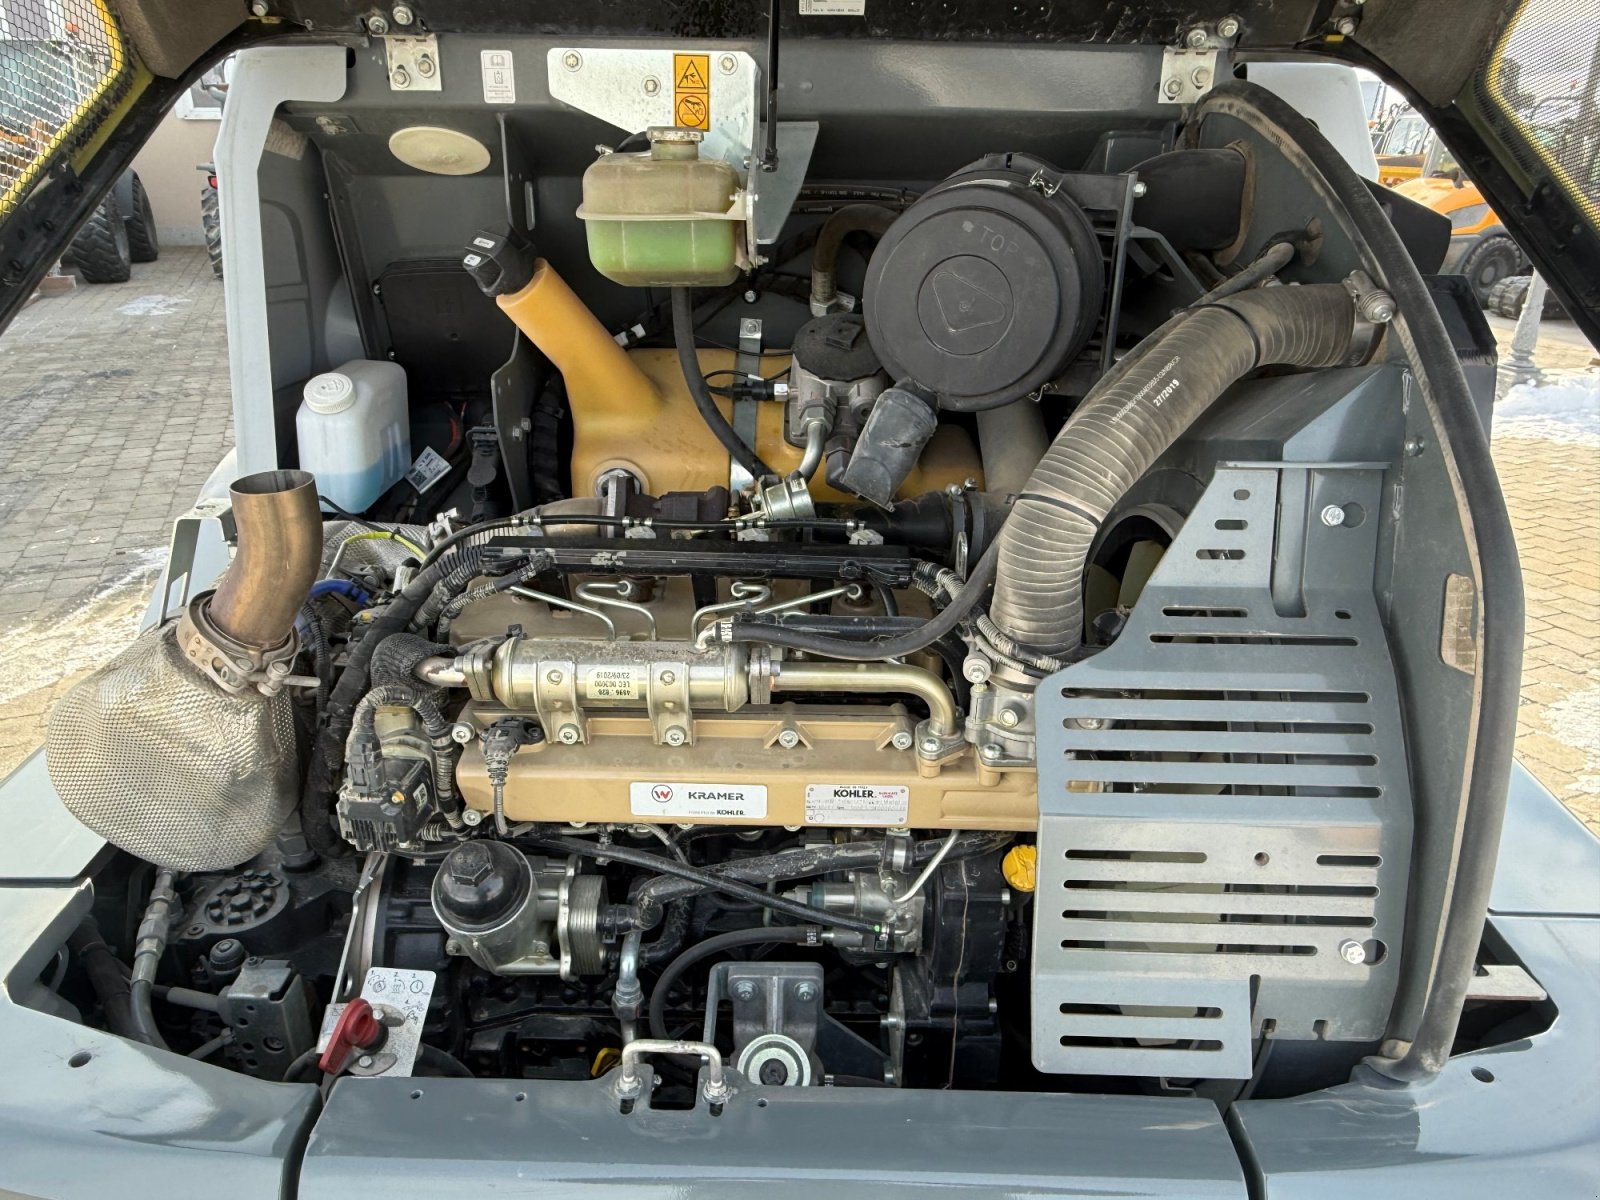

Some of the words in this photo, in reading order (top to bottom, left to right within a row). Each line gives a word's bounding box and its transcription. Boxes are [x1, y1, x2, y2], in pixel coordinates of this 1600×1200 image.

[981, 225, 1020, 256] TOP
[1153, 379, 1180, 407] 27/2019
[688, 791, 745, 801] KRAMER
[833, 789, 874, 798] KOHLER
